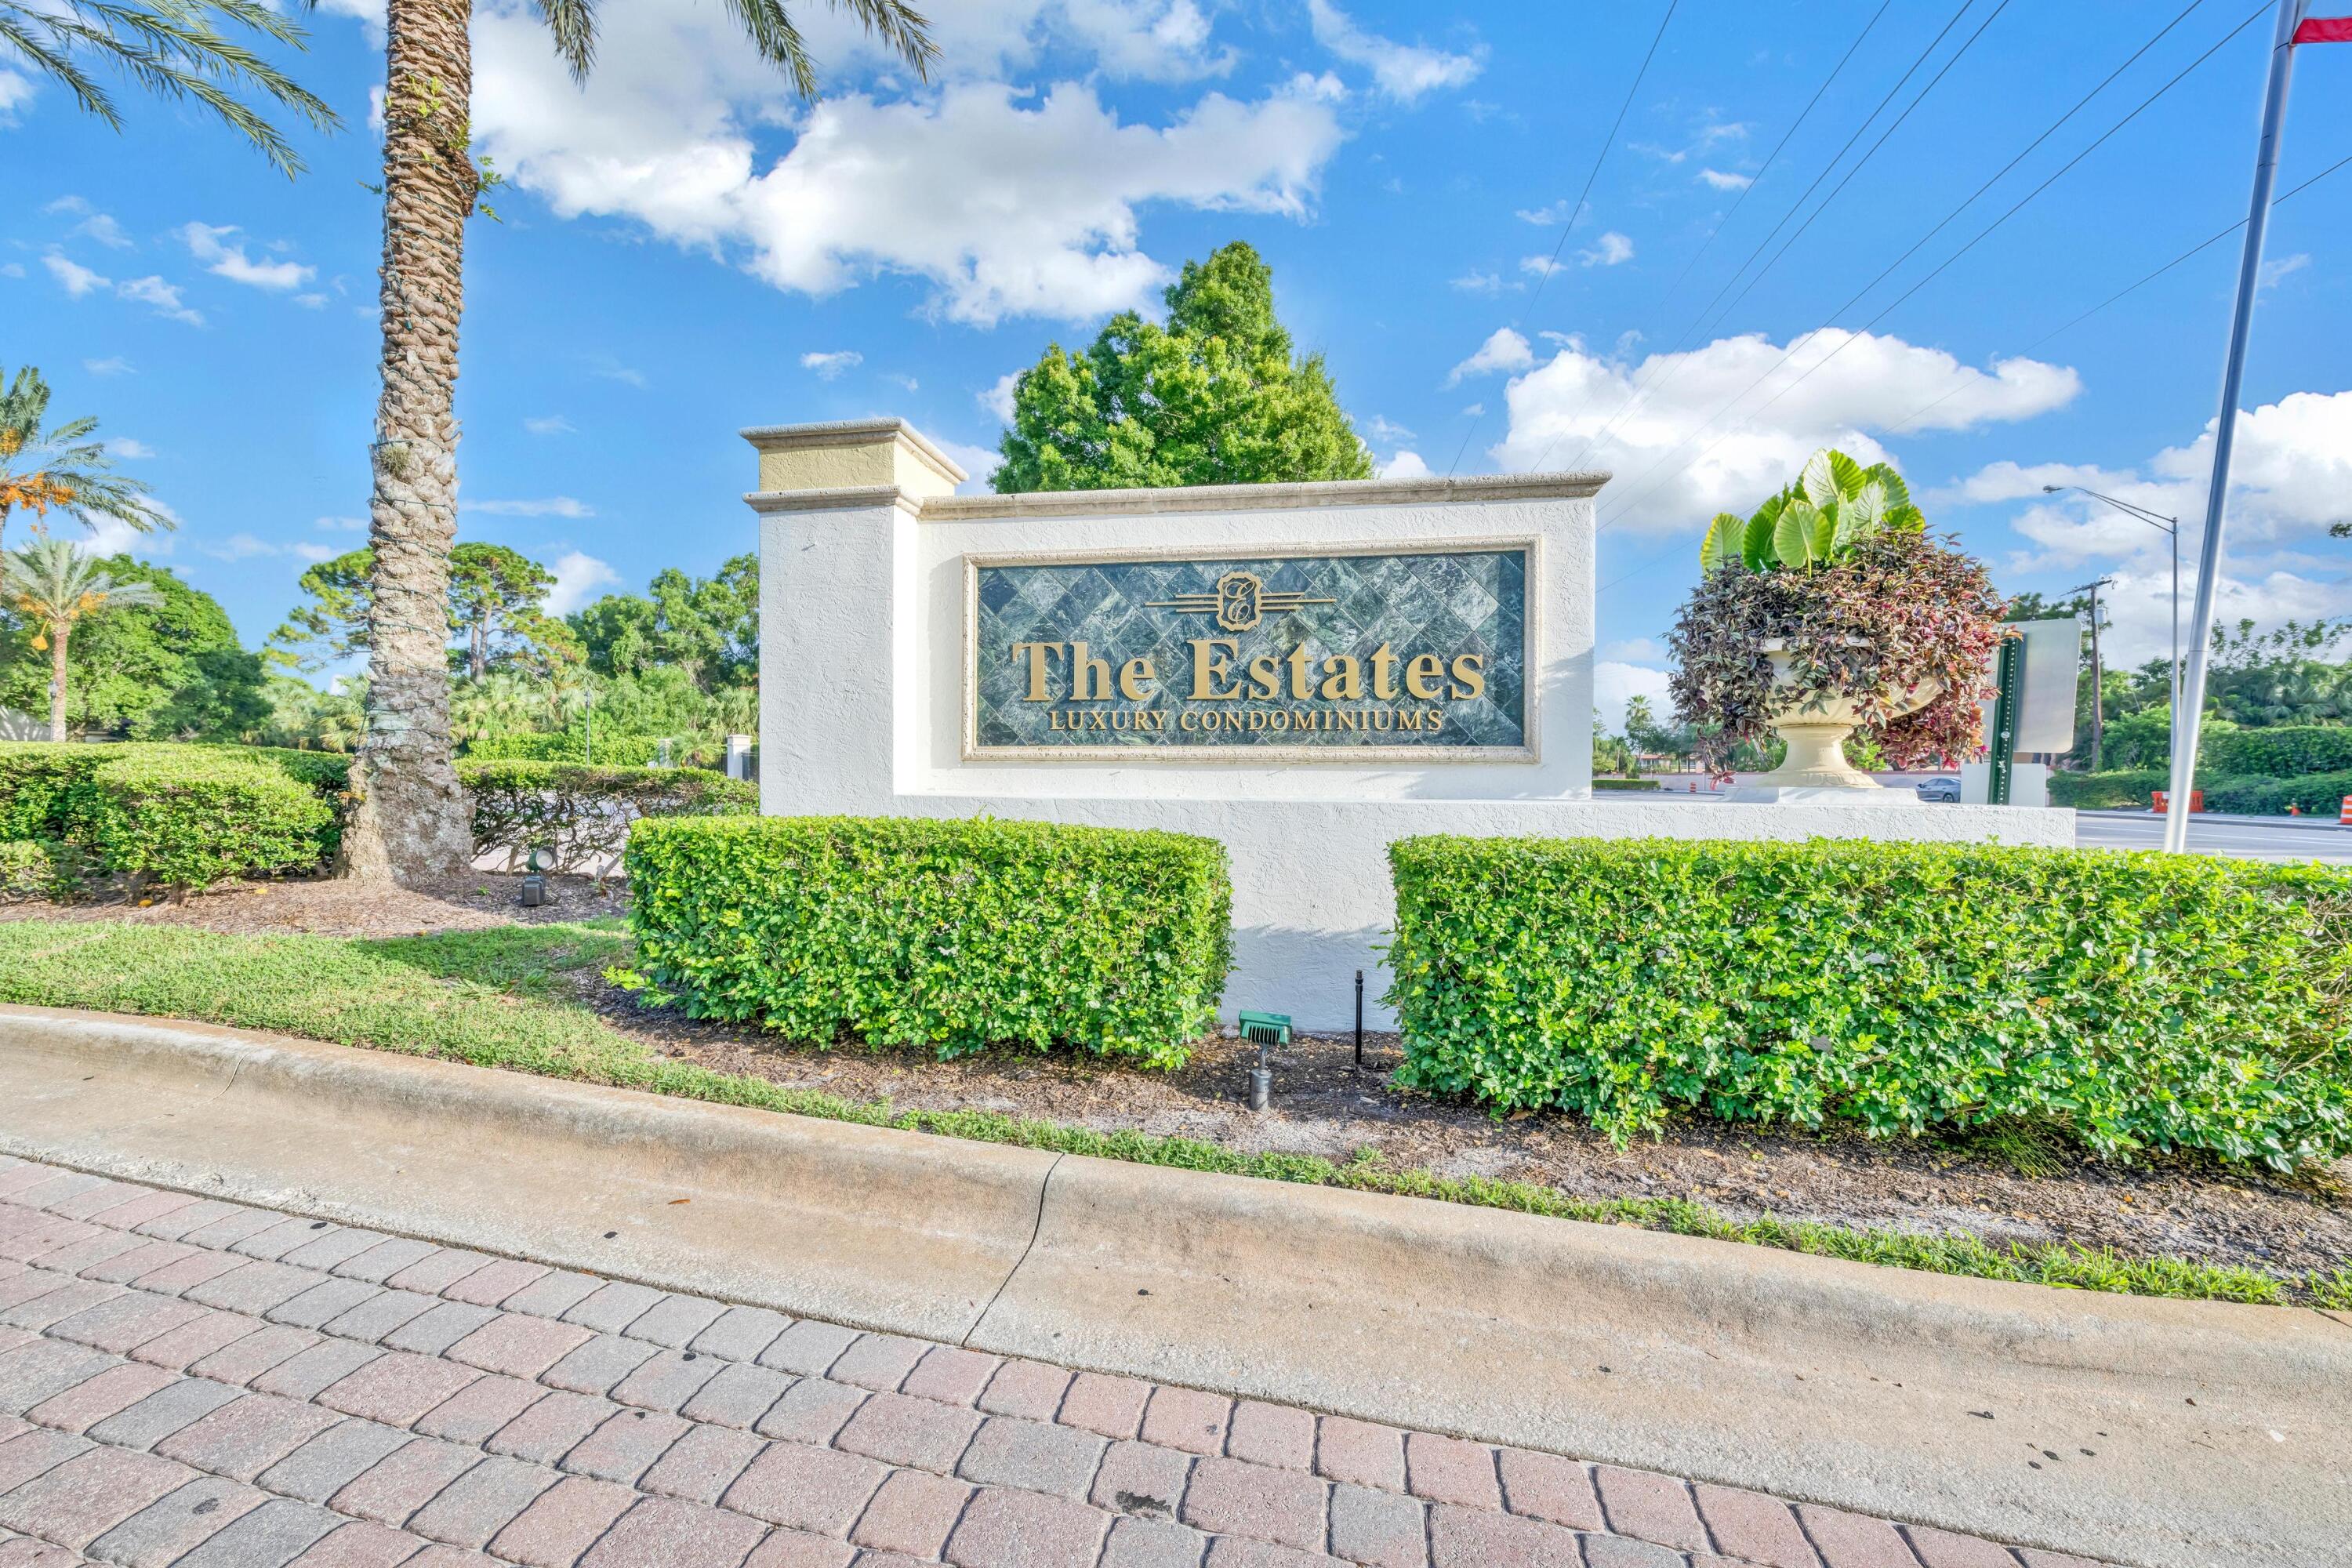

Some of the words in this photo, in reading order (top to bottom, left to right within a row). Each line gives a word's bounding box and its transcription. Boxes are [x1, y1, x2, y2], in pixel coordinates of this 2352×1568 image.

[1013, 641, 1156, 702] The
[1187, 639, 1486, 700] Estates
[1050, 710, 1167, 731] LUXURY
[1181, 710, 1443, 731] CONDOMINIUMS
